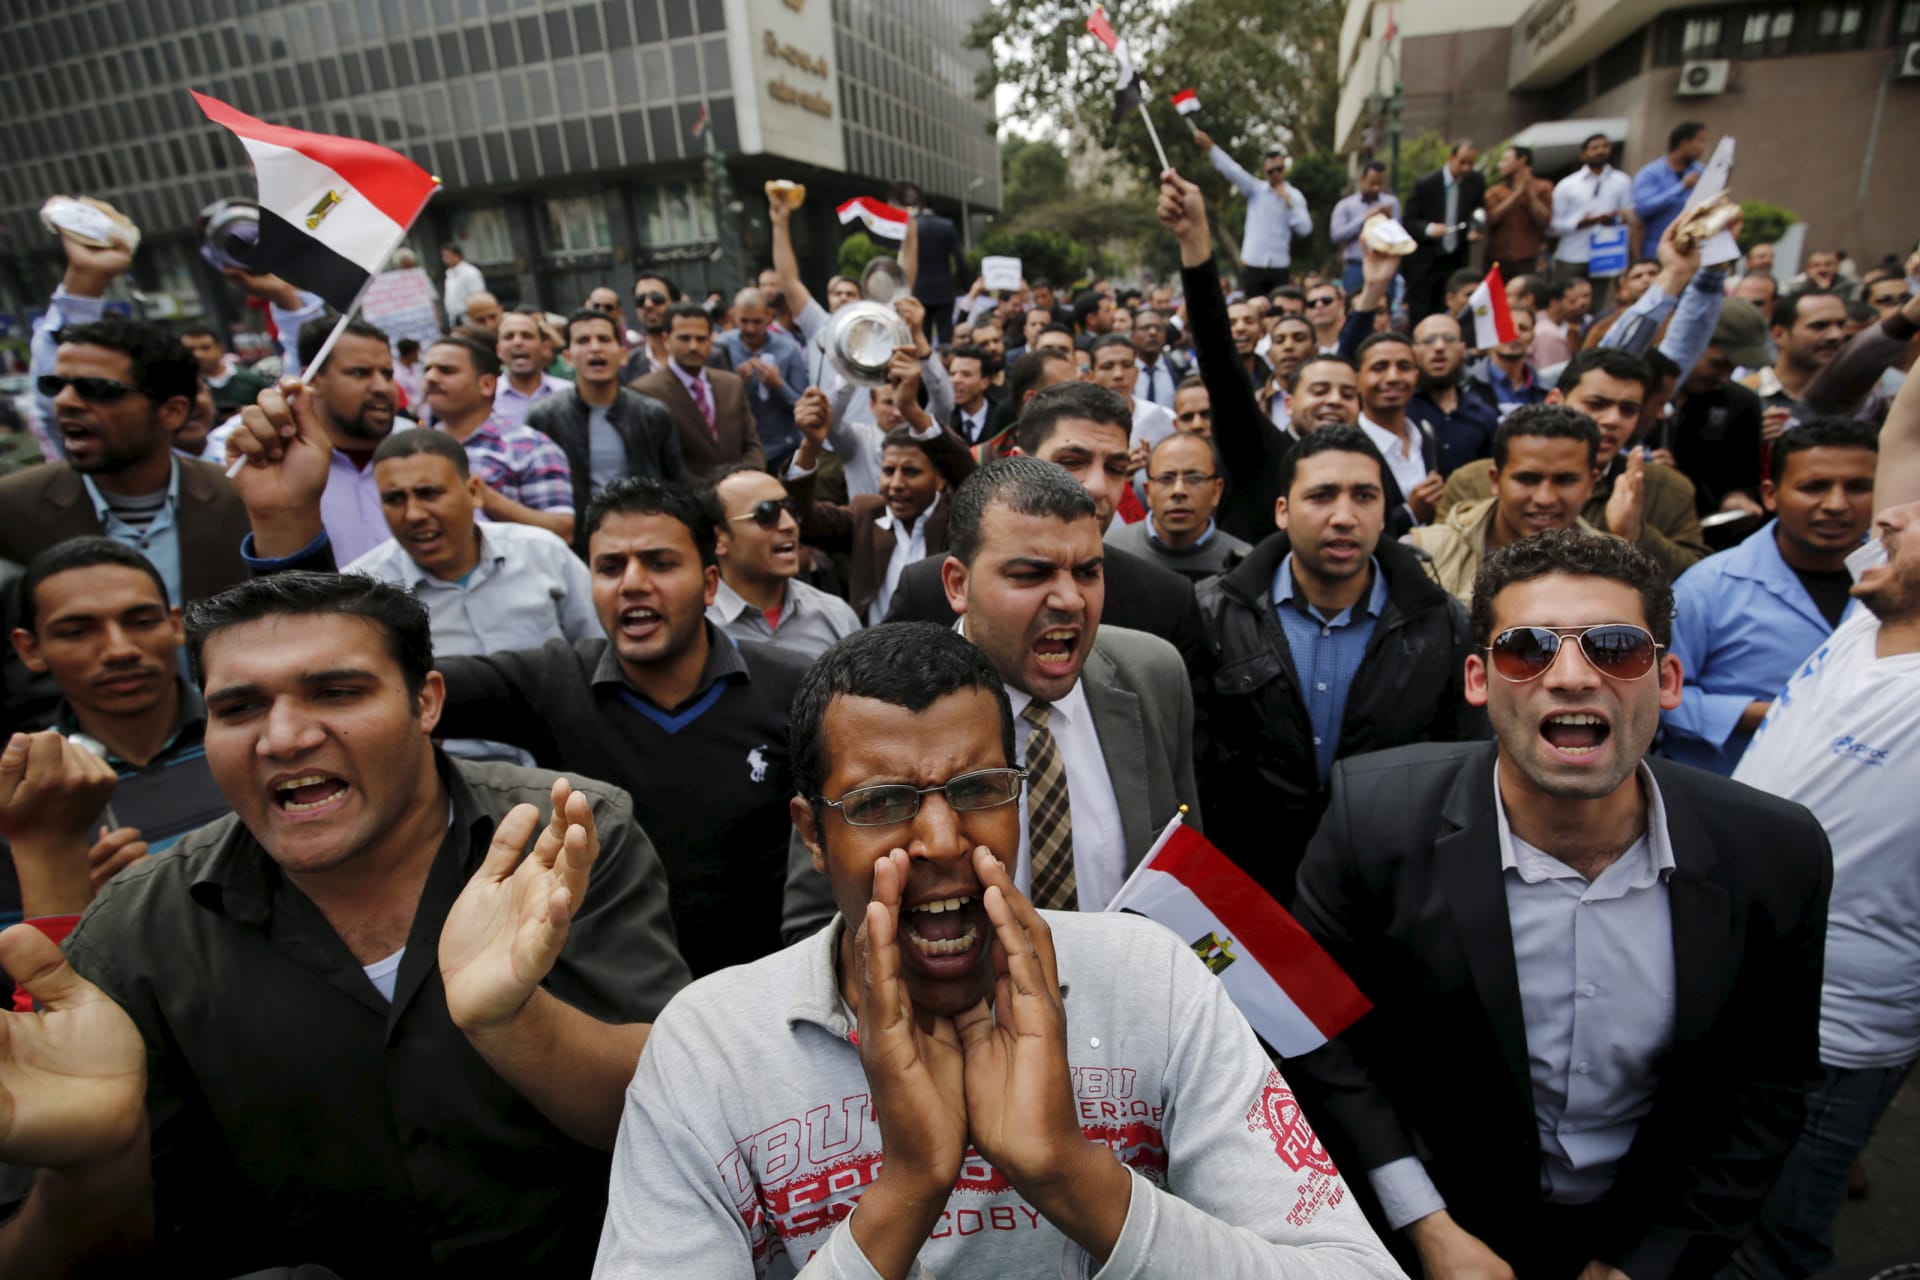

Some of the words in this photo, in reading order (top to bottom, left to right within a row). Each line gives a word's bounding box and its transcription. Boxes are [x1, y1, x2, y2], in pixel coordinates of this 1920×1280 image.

[1069, 1066, 1137, 1100] BU
[717, 1093, 869, 1207] UBU
[1282, 1114, 1313, 1166] FUB
